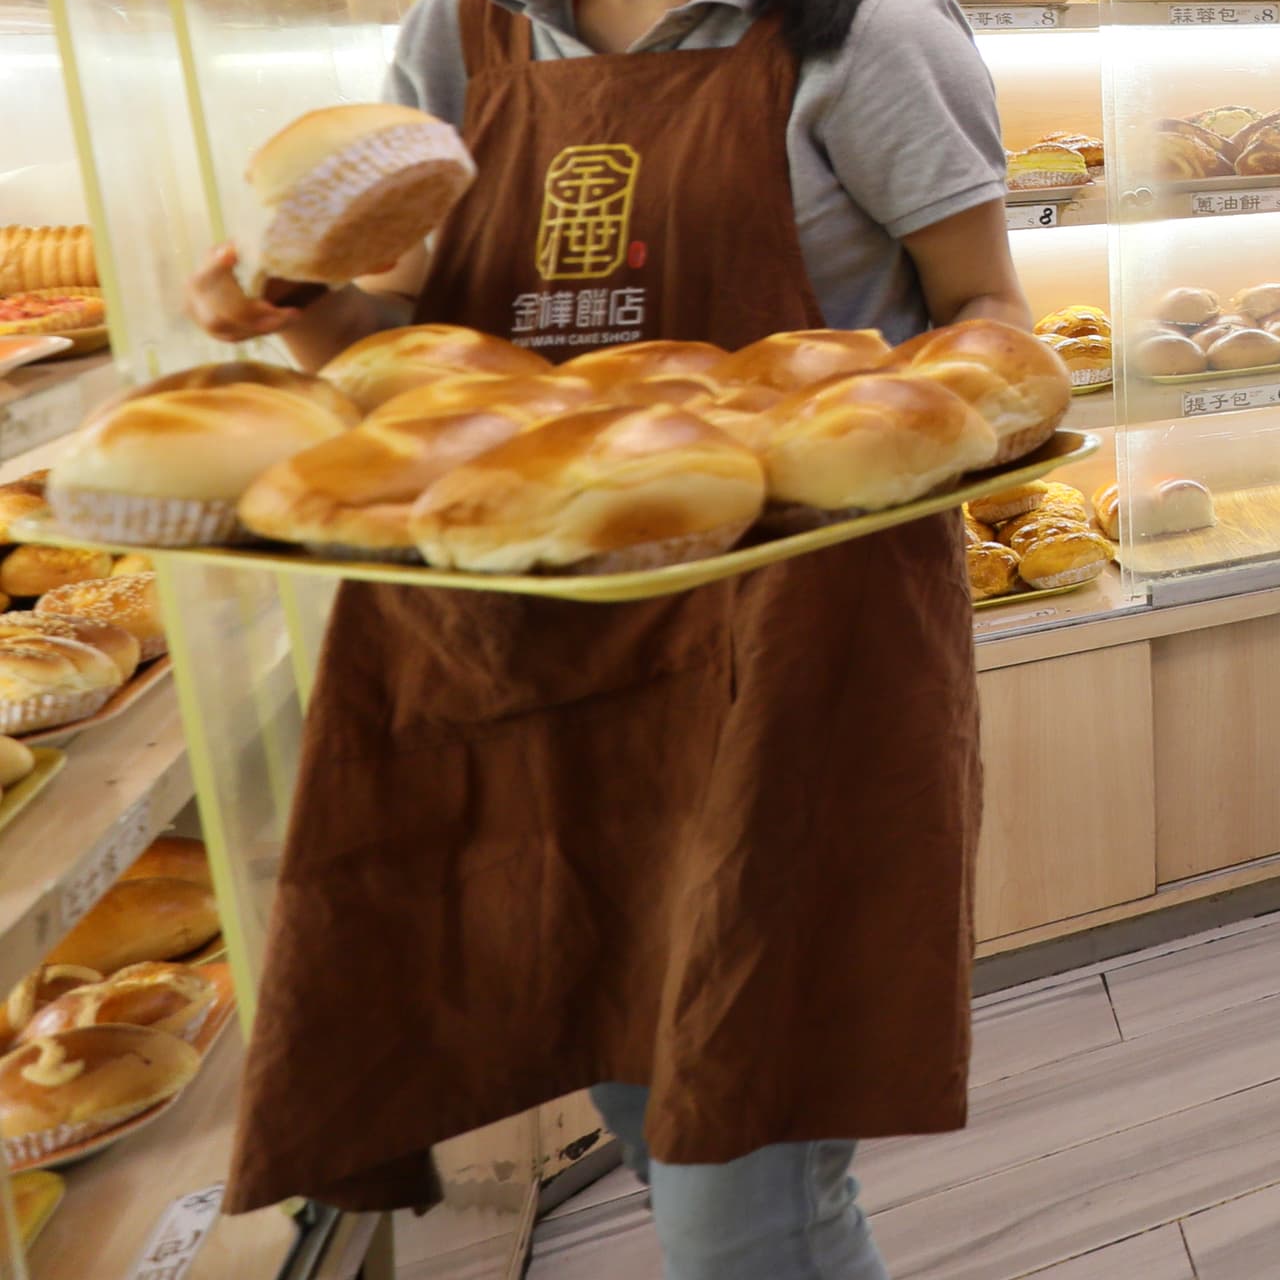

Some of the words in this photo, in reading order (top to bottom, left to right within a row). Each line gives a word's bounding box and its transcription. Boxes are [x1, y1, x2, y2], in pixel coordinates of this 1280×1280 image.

[1173, 8, 1239, 24] 蒜蓉包
[1186, 392, 1250, 413] 提子包
